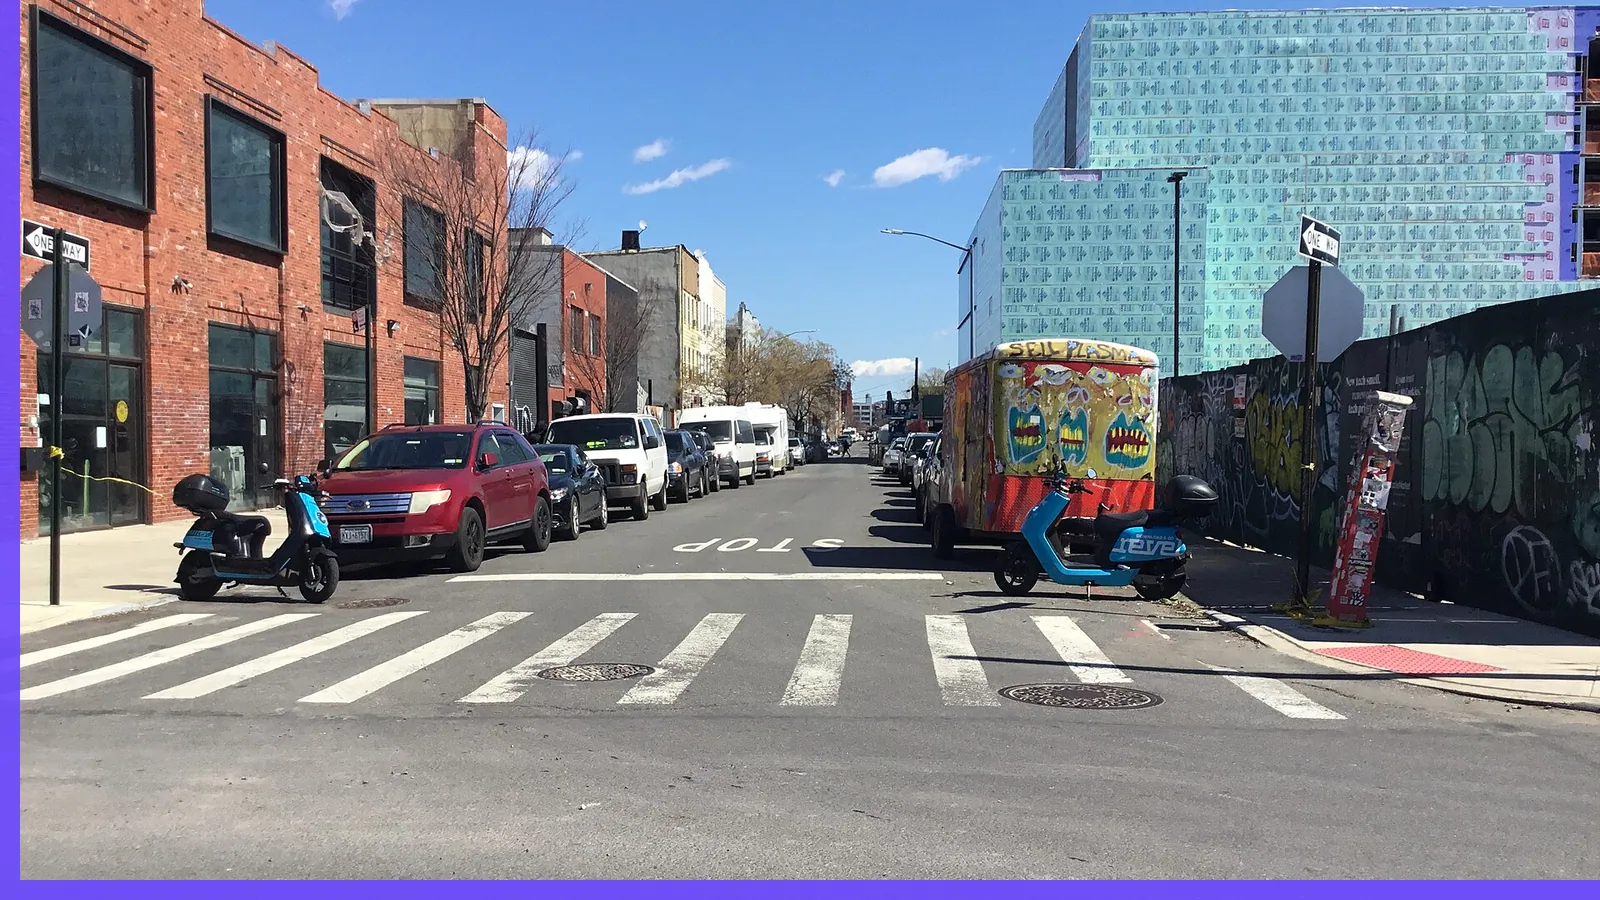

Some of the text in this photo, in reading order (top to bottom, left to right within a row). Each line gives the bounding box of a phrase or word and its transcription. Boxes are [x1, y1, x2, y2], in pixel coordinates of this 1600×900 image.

[33, 234, 81, 260] ONE WAY
[1307, 230, 1338, 254] ONE WAY
[1009, 340, 1143, 362] SELL PLASMA
[672, 537, 845, 552] STOP
